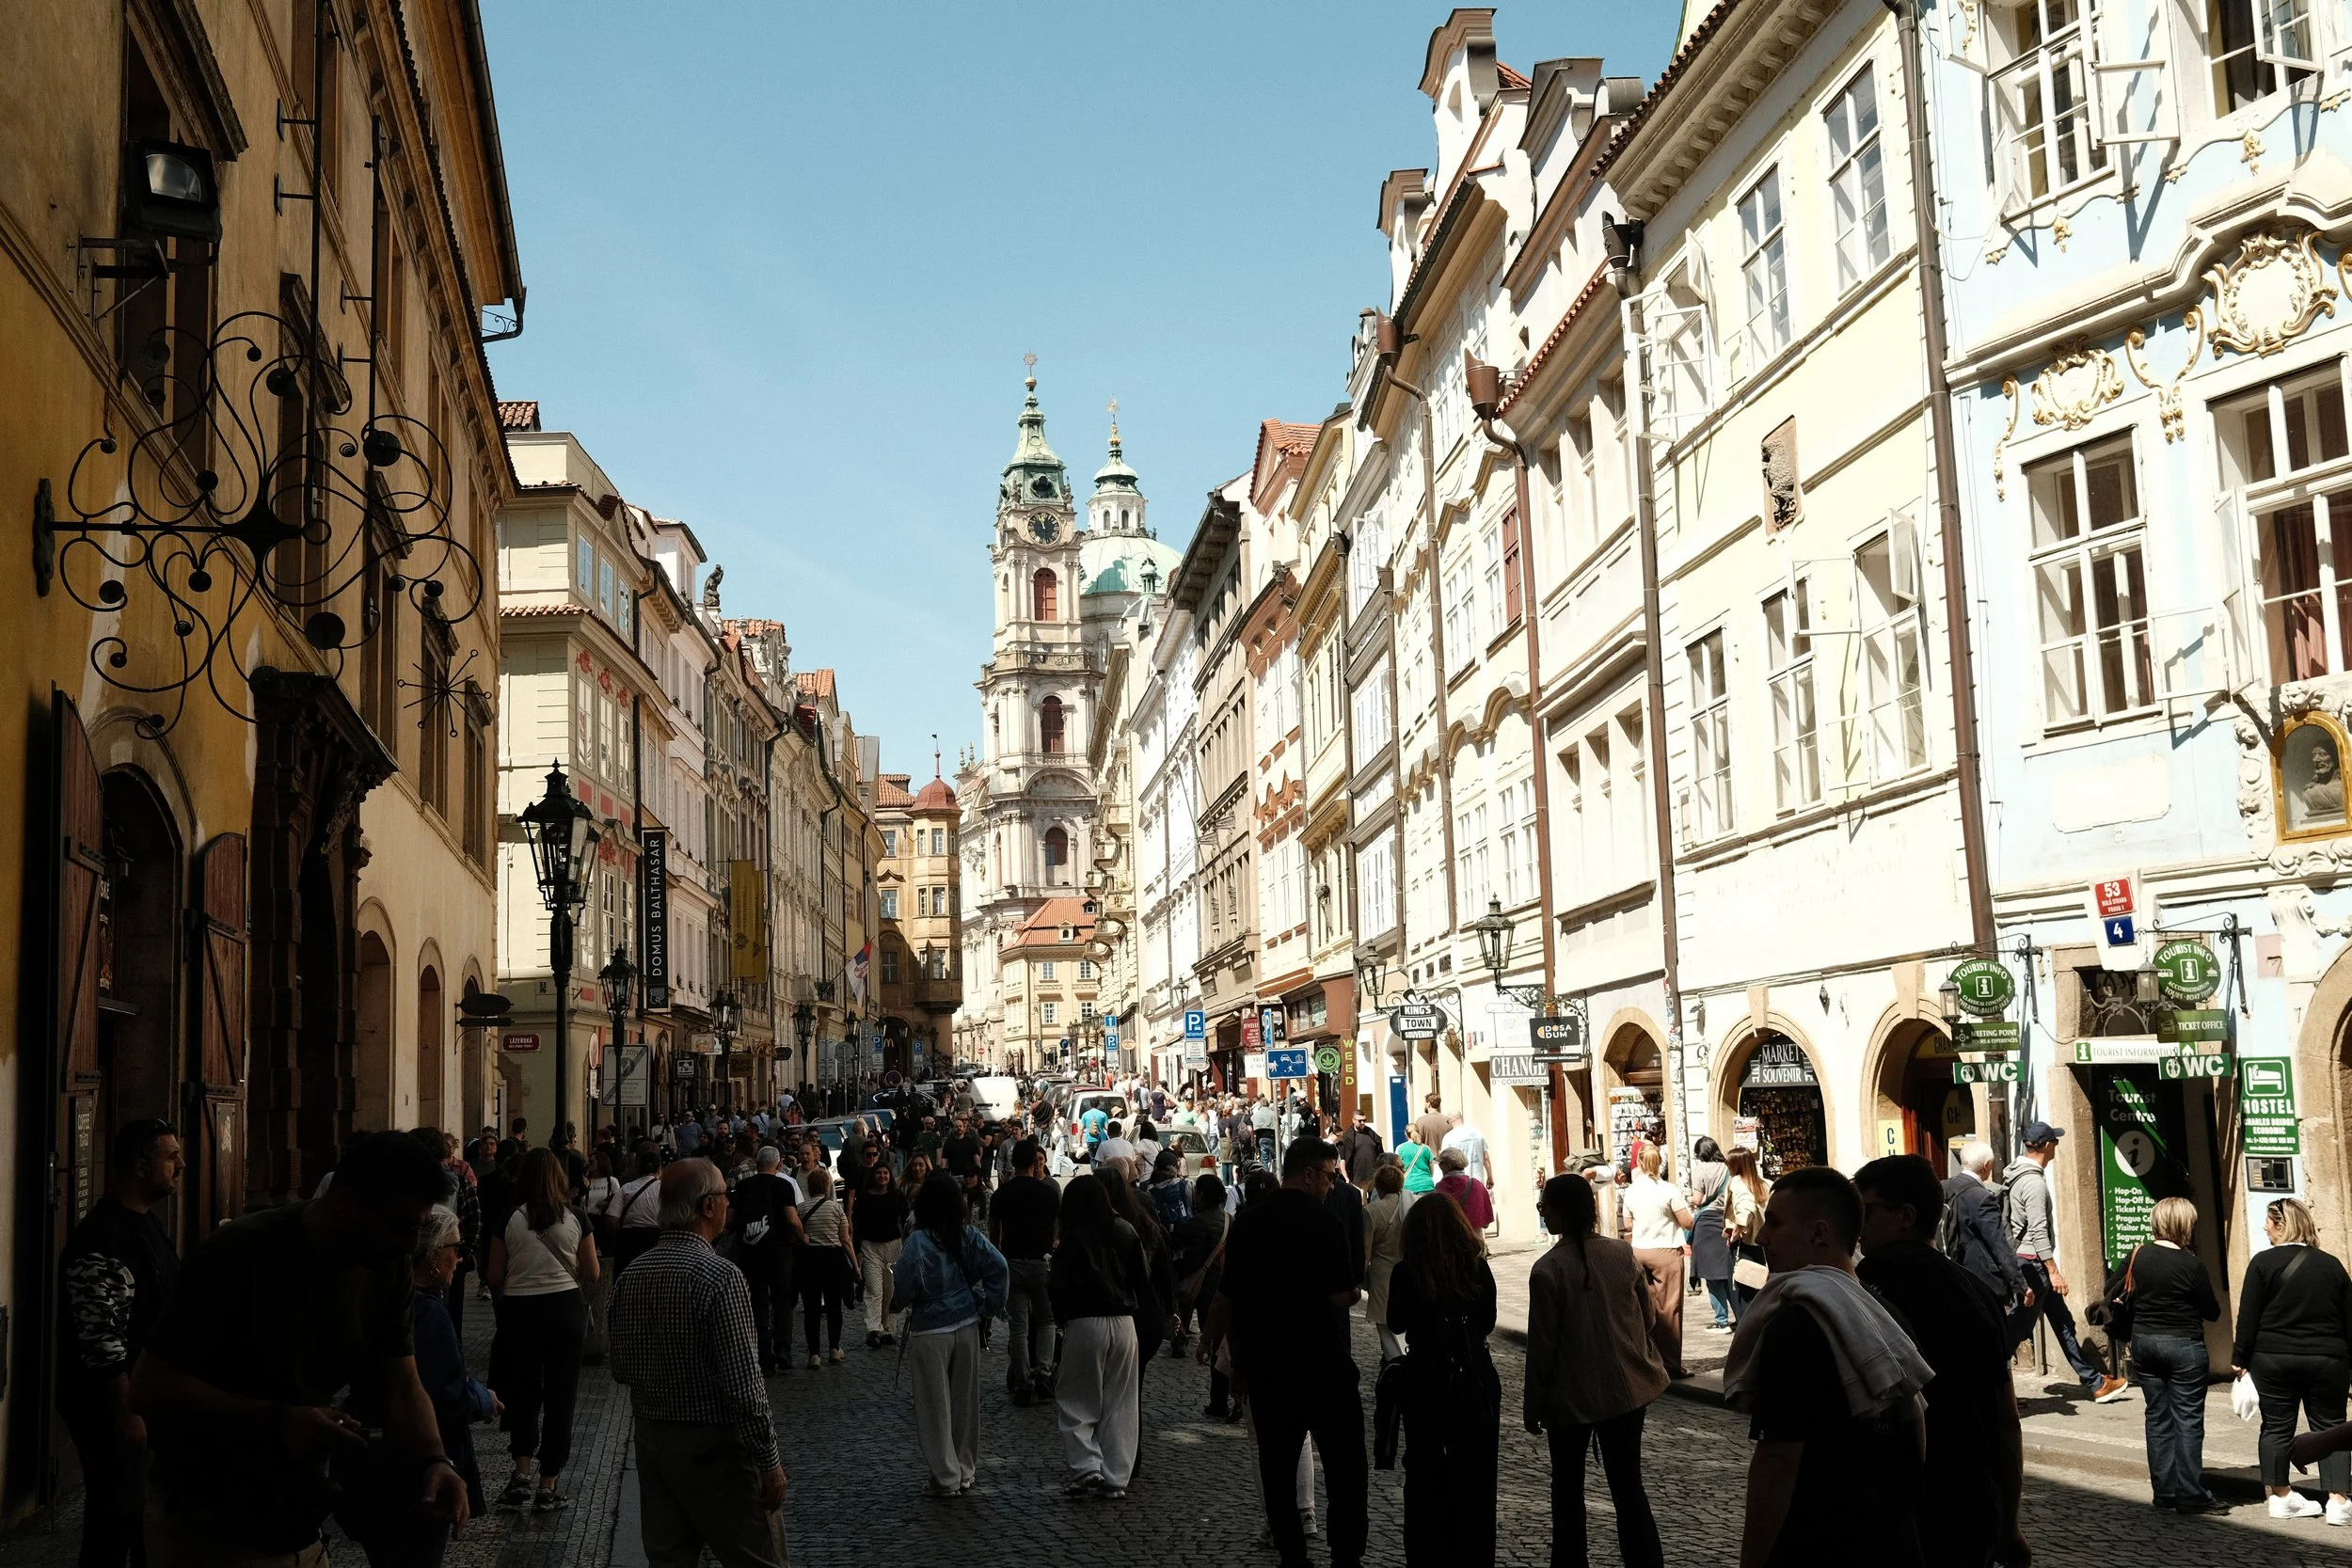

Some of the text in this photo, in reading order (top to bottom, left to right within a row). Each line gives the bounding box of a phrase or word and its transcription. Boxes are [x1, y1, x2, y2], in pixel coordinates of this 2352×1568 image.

[2104, 881, 2121, 897] 53
[650, 839, 662, 976] DOMUS BALTHASAR
[2113, 923, 2123, 939] 4
[2158, 943, 2213, 963] TOURIST INFO
[1955, 962, 2008, 980] TOURIST INFO
[2168, 981, 2210, 992] ACCOMMODATION
[2165, 987, 2183, 999] TOURS
[1963, 994, 1985, 1006] CLASSICAL
[1998, 997, 2010, 1009] JAZZ
[1404, 1006, 1431, 1015] KING'S
[1405, 1019, 1432, 1028] TOWN
[2178, 1021, 2224, 1030] TICKET OFFICE
[1405, 1030, 1433, 1038] SOUVENIRS
[1762, 1043, 1799, 1063] MARKET
[2093, 1048, 2123, 1056] TOURIST
[1343, 1039, 1355, 1085] WEED
[1491, 1056, 1547, 1077] CHANGE
[2182, 1055, 2225, 1077] WC
[1762, 1068, 1802, 1083] SOUVENIR
[1979, 1062, 2018, 1082] WC
[2108, 1089, 2156, 1103] Tourist
[2244, 1099, 2294, 1114] HOSTEL
[2110, 1109, 2156, 1122] Centre
[2245, 1117, 2296, 1126] CHARLES BRIDGE
[2252, 1127, 2286, 1135] ECONOMIC
[2115, 1187, 2142, 1196] Hop-On
[2115, 1196, 2144, 1205] Hop-Off
[2115, 1215, 2141, 1224] Prague
[746, 1214, 769, 1238] NIKE
[2116, 1233, 2145, 1242] Segway
